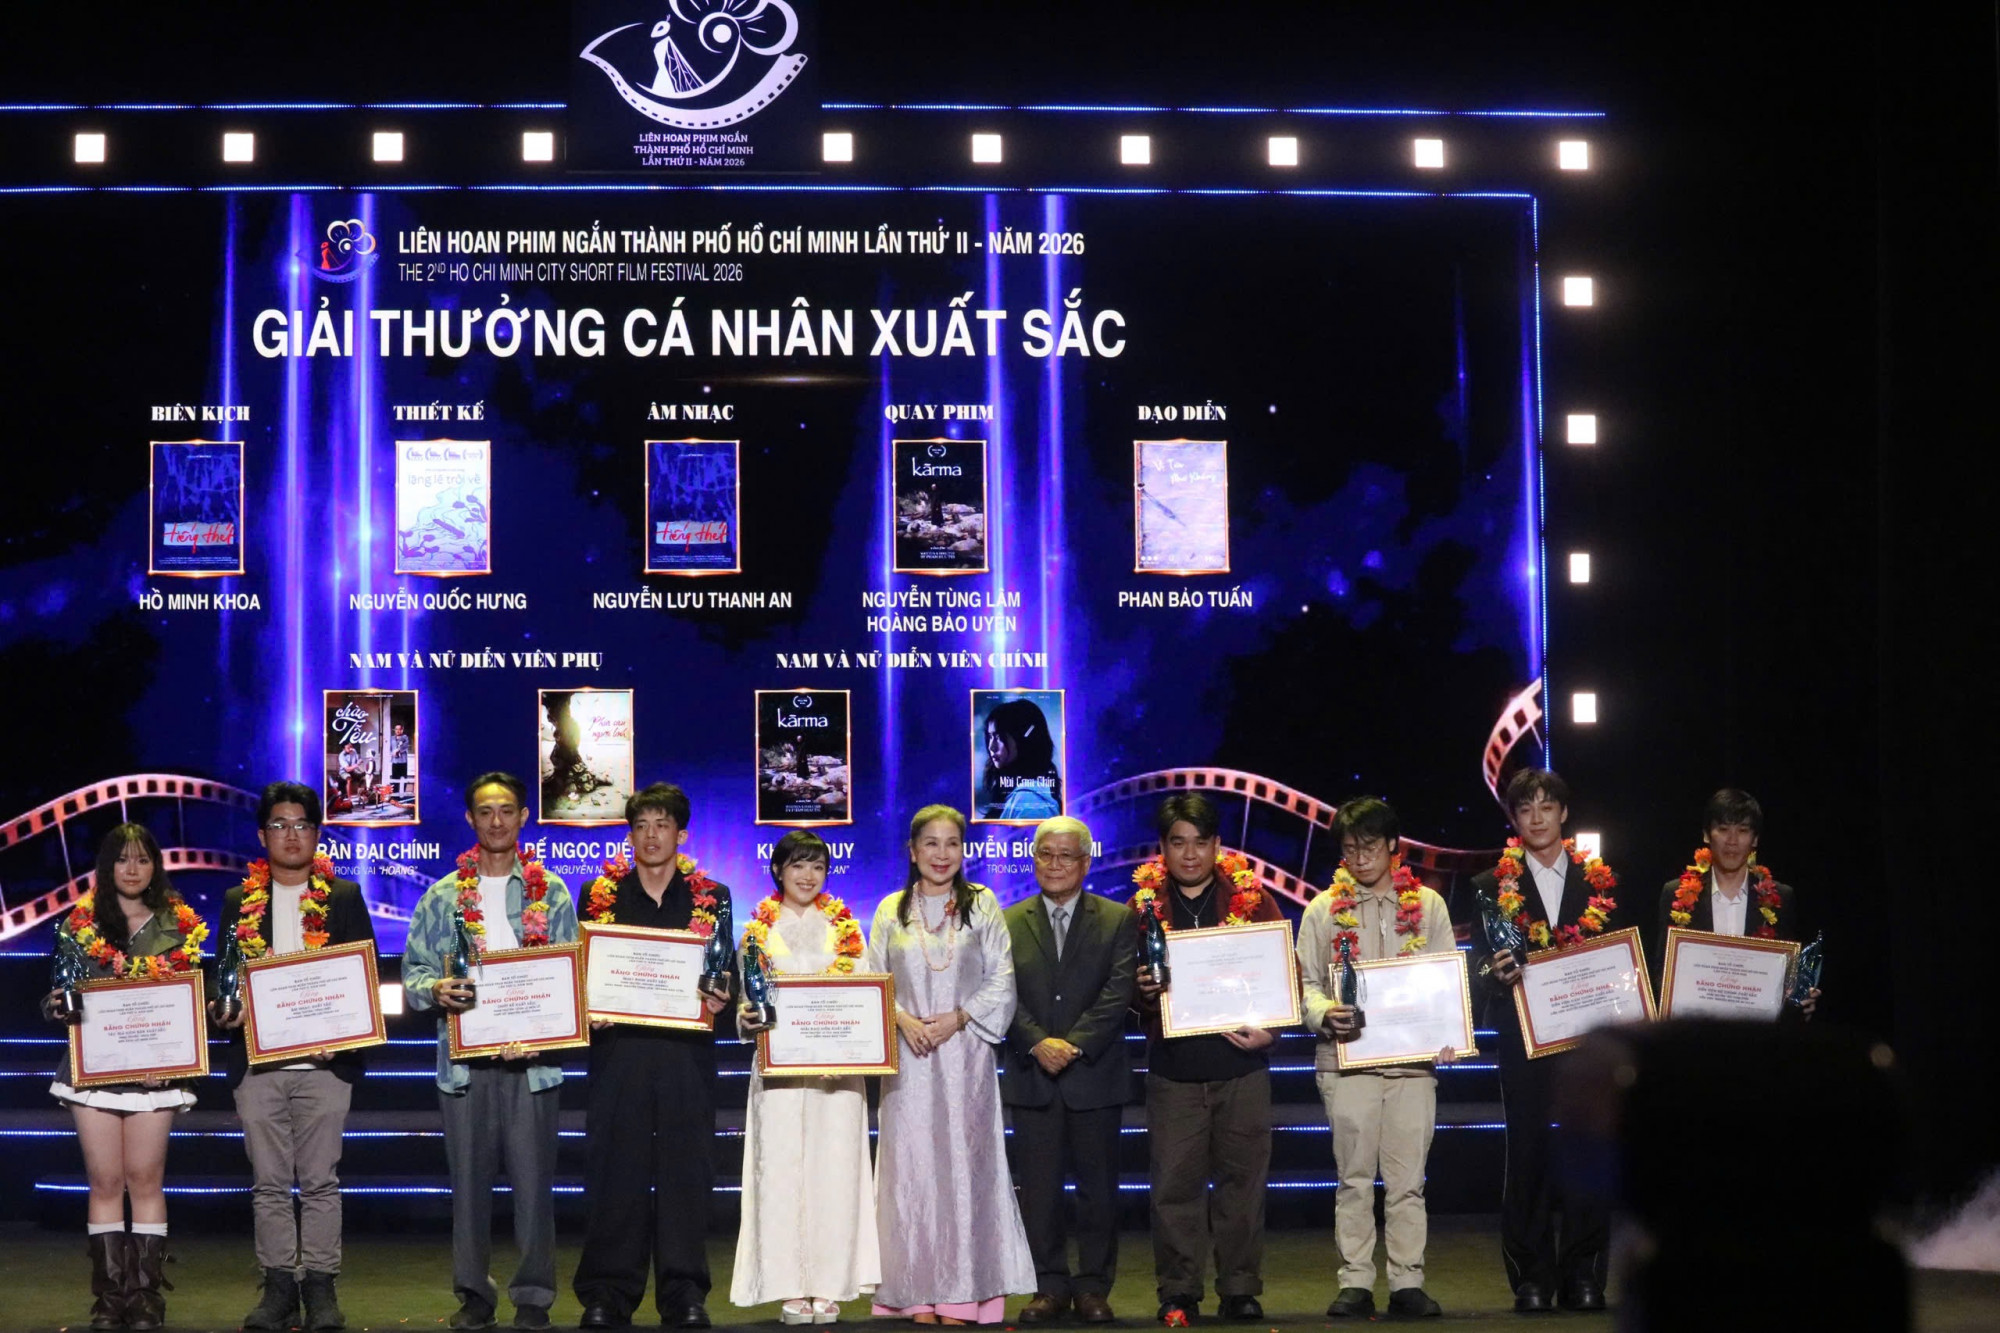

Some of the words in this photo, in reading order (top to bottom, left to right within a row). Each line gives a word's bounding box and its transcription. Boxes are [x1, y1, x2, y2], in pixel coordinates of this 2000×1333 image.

[633, 143, 669, 154] THÀNH
[670, 142, 691, 154] PHỐ
[692, 143, 707, 154] HỒ
[708, 143, 725, 154] CHÍ
[727, 145, 754, 154] MINH
[639, 132, 662, 143] LIÊN
[663, 133, 690, 143] HOAN
[692, 133, 719, 143] PHIM
[720, 130, 748, 143] NGẮN
[642, 155, 662, 166] LẦN
[663, 156, 685, 166] THỨ
[686, 157, 692, 166] II
[700, 156, 722, 166] NĂM
[724, 157, 746, 166] 2026
[398, 226, 441, 254] LIÊN
[447, 231, 500, 254] HOAN
[506, 231, 556, 254] PHIM
[562, 220, 616, 254] NGẮN
[621, 225, 686, 254] THÀNH
[692, 222, 731, 254] PHỐ
[737, 222, 764, 254] HỒ
[769, 226, 802, 254] CHÍ
[807, 231, 858, 254] MINH
[864, 223, 901, 254] LẦN
[906, 226, 950, 254] THỨ
[956, 232, 968, 254] II
[988, 227, 1032, 254] NĂM
[1038, 232, 1085, 255] 2026
[398, 263, 423, 282] THE
[427, 262, 446, 282] 2ND
[449, 263, 469, 282] HO
[472, 263, 496, 282] CHI
[499, 263, 534, 282] MINH
[537, 263, 567, 282] CITY
[569, 263, 614, 282] SHORT
[618, 263, 647, 282] FILM
[650, 263, 709, 282] FESTIVAL
[713, 263, 743, 282] 2026
[252, 296, 354, 358] GIẢI
[370, 293, 606, 358] THƯỞNG
[622, 297, 695, 358] CÁ
[711, 297, 854, 357] NHÂN
[869, 291, 1007, 357] XUẤT
[1022, 288, 1127, 358] SẮC
[151, 404, 197, 422] BIÊN
[202, 405, 250, 424] KỊCH
[393, 401, 453, 422] THIẾT
[457, 402, 484, 422] KẾ
[647, 402, 677, 421] ÂM
[681, 404, 735, 425] NHẠC
[884, 404, 938, 424] QUAY
[942, 404, 995, 420] PHIM
[1182, 399, 1227, 421] DIỄN
[139, 588, 164, 611] HỒ
[168, 594, 209, 611] MINH
[213, 594, 261, 611] KHOA
[349, 586, 418, 611] NGUYỄN
[422, 588, 472, 612] QUỐC
[476, 592, 527, 611] HƯNG
[593, 585, 661, 609] NGUYỄN
[666, 590, 703, 609] LƯU
[708, 592, 765, 609] THANH
[768, 592, 792, 609] AN
[862, 584, 931, 608] NGUYỄN
[935, 587, 981, 608] TÙNG
[986, 588, 1021, 608] LÂM
[1118, 590, 1164, 608] PHAN
[1168, 586, 1203, 608] BẢO
[1207, 585, 1253, 608] TUẤN
[867, 611, 927, 632] HOÀNG
[931, 611, 968, 632] BẢO
[349, 653, 392, 669] NAM
[396, 650, 425, 669] VÀ
[429, 650, 456, 669] NỮ
[460, 646, 506, 669] DIỄN
[510, 649, 557, 669] VIÊN
[561, 652, 604, 672] PHỤ
[776, 653, 819, 669] NAM
[823, 650, 851, 669] VÀ
[855, 650, 883, 669] NỮ
[887, 646, 933, 669] DIỄN
[937, 650, 983, 669] VIÊN
[988, 649, 1049, 669] CHÍNH
[316, 837, 352, 860] RẦN
[356, 842, 384, 863] ĐẠI
[388, 838, 440, 860] CHÍNH
[552, 841, 601, 862] NGỌC
[962, 835, 1010, 858] UYỄN
[987, 864, 1018, 874] TRONG
[1019, 864, 1034, 874] VAI
